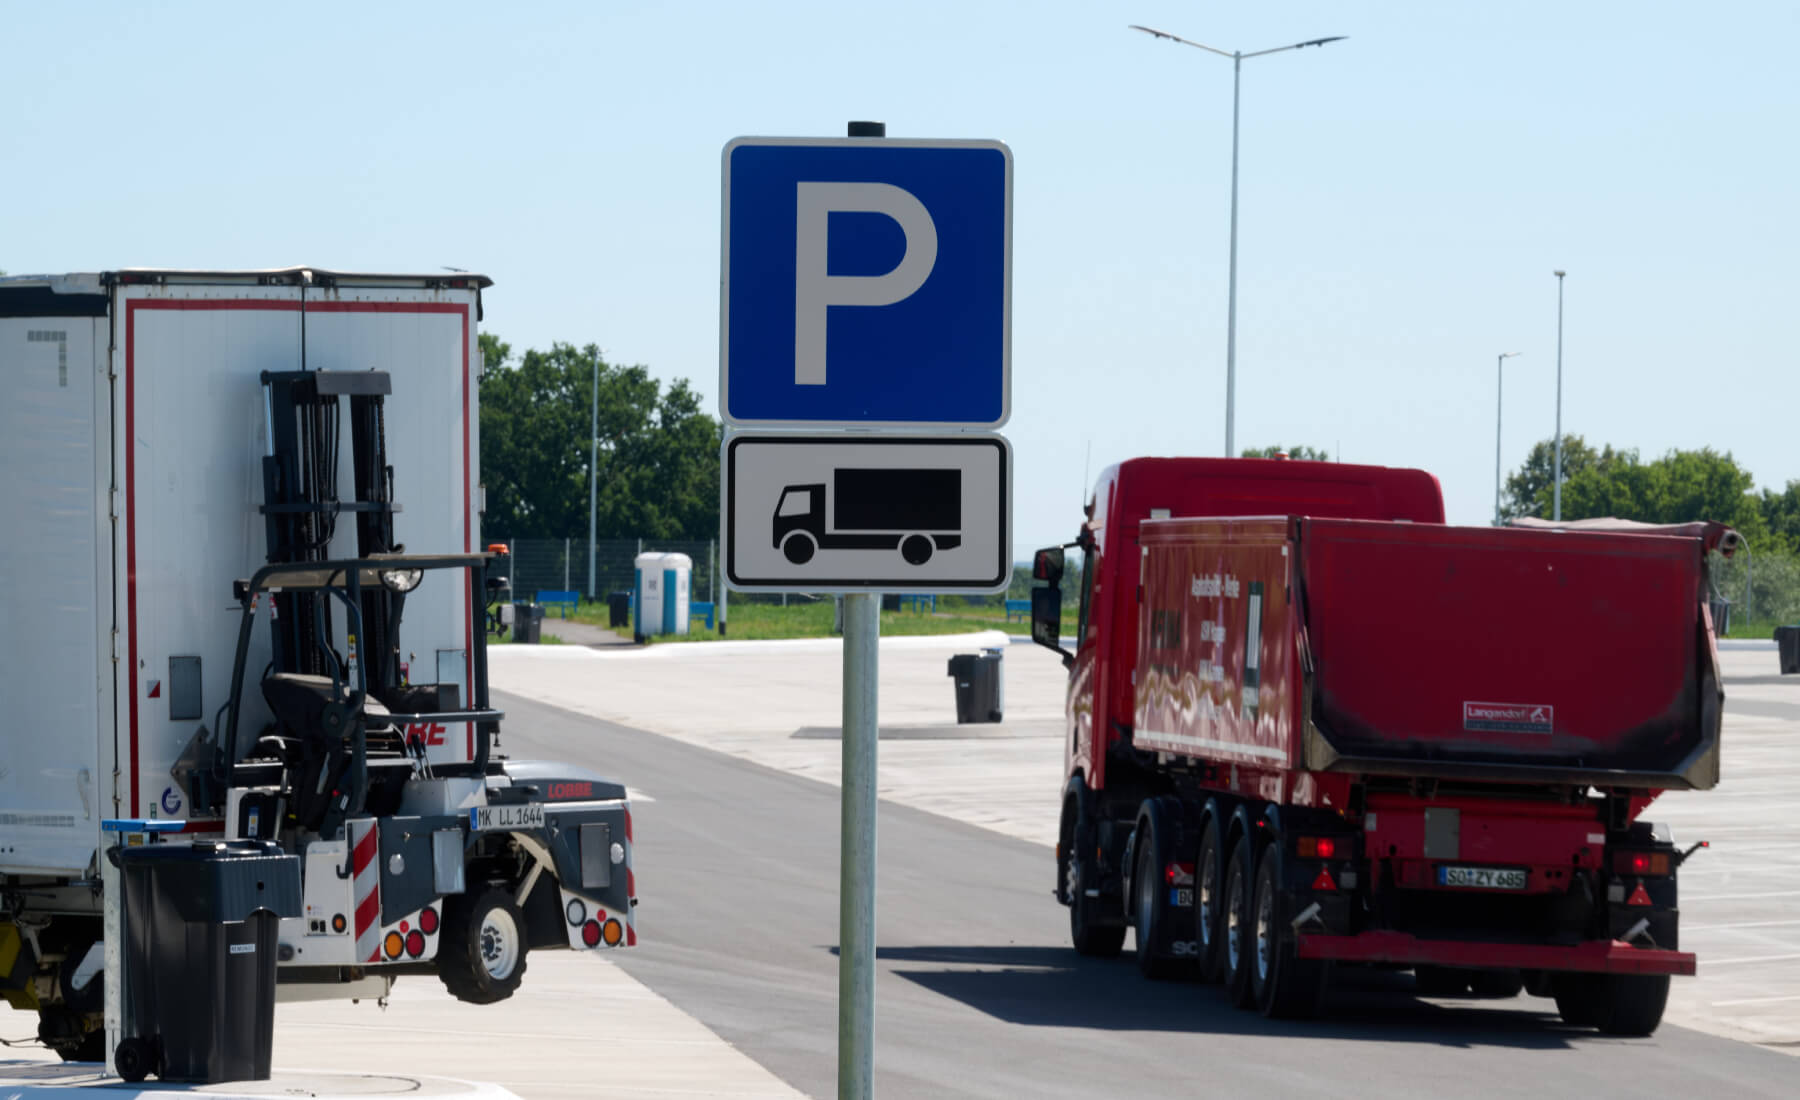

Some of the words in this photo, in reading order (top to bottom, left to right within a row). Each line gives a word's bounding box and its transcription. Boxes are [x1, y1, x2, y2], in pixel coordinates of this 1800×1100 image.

[795, 181, 938, 385] P
[547, 782, 593, 798] LOBBE
[478, 808, 492, 826] MK
[499, 807, 513, 825] LL
[517, 804, 543, 825] 1644
[1475, 871, 1495, 885] ZY
[1496, 872, 1524, 888] 685
